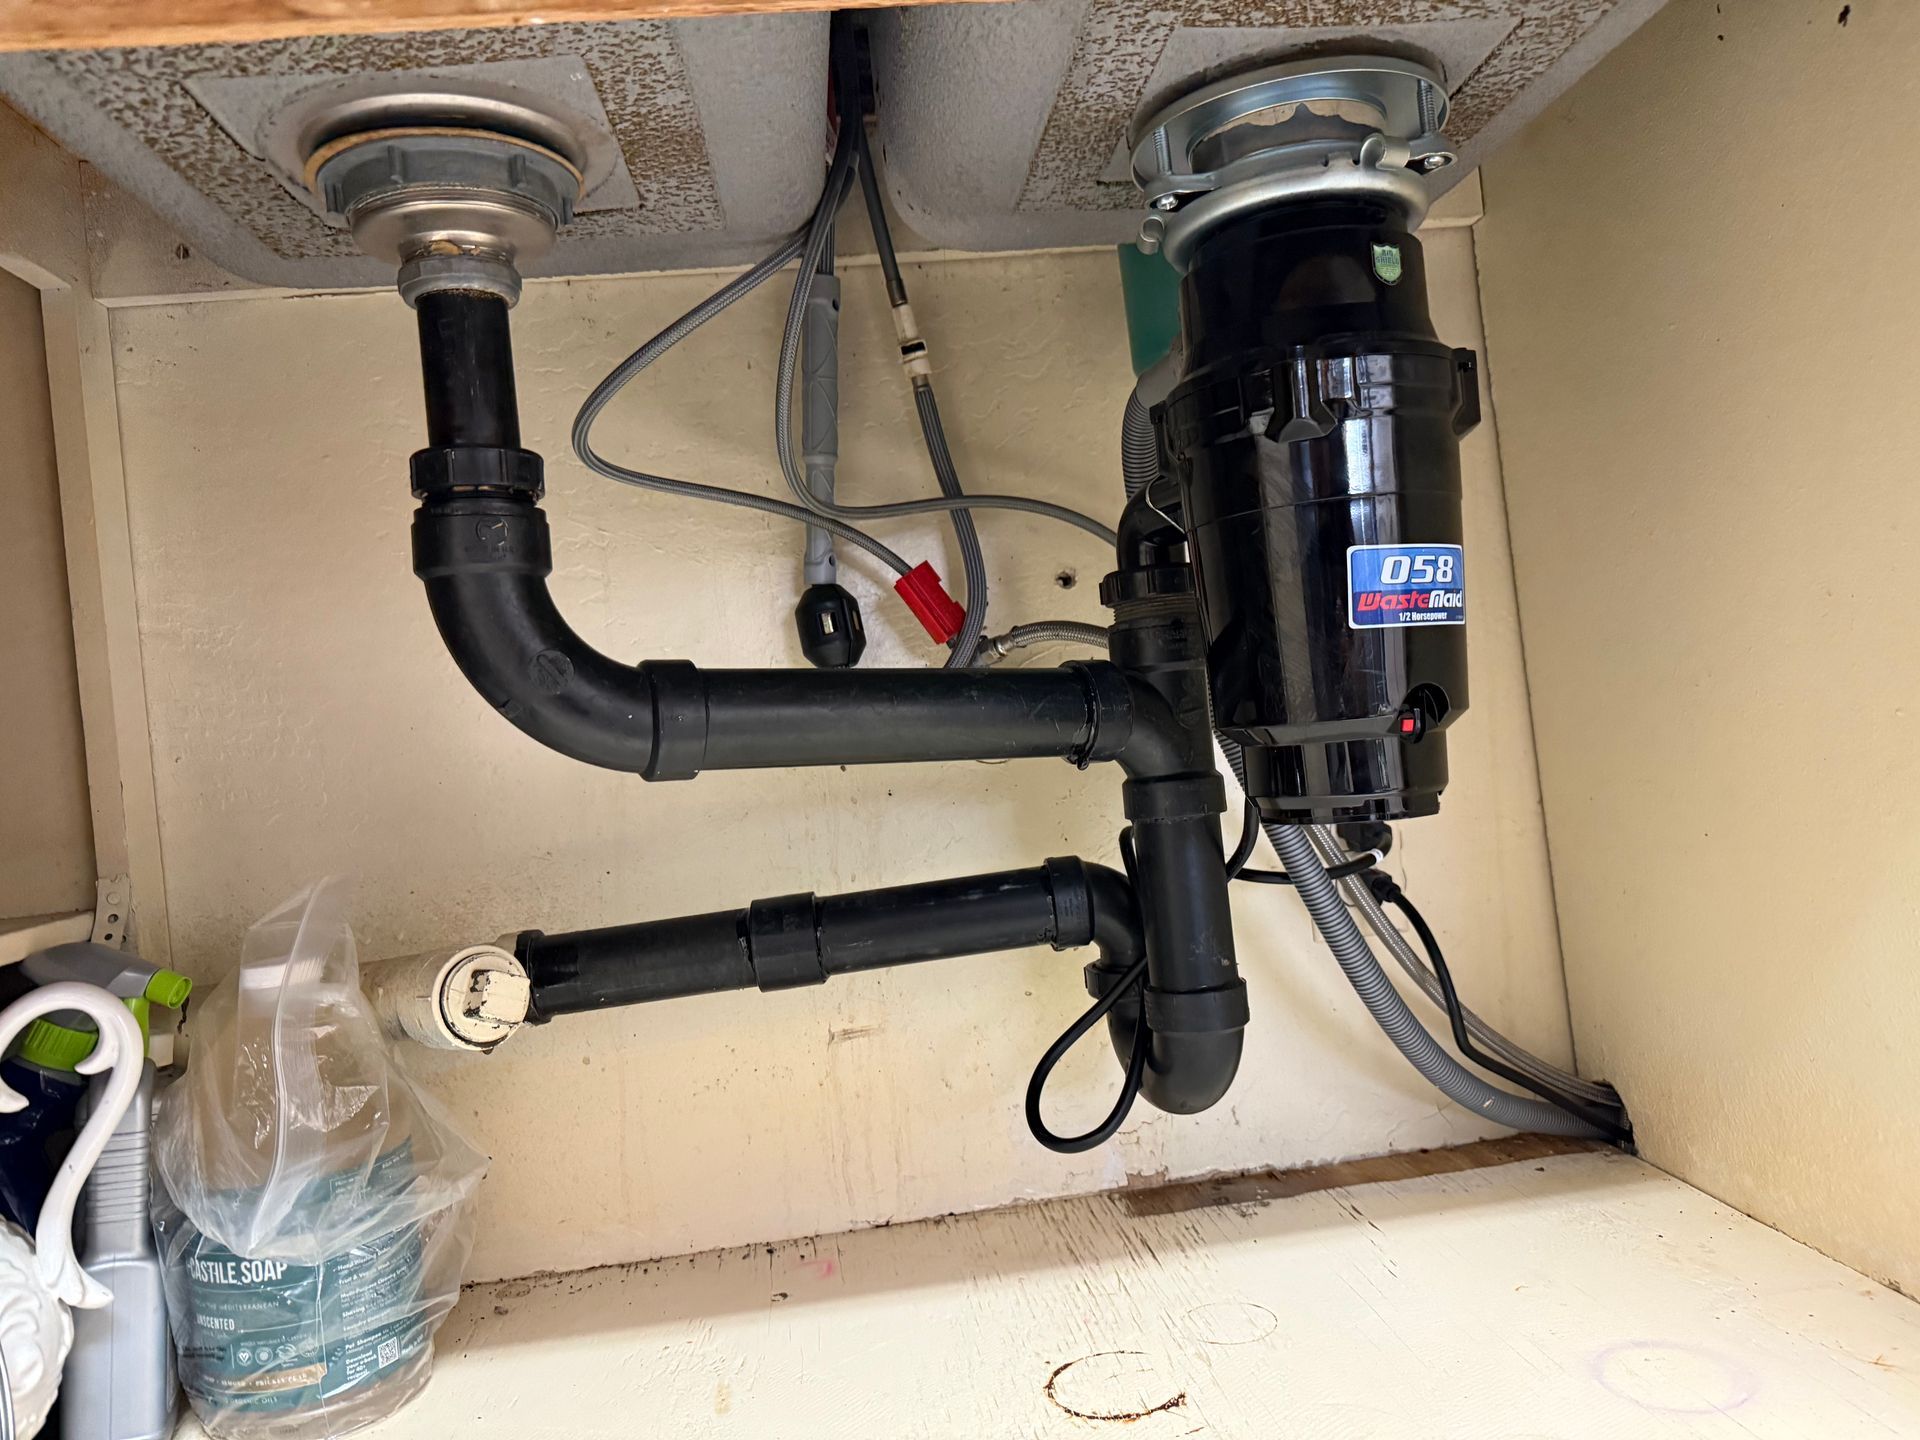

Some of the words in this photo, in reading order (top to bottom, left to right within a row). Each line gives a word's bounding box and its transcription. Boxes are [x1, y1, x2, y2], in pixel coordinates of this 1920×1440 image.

[1380, 555, 1454, 584] 058
[1398, 612, 1411, 622] 1/2
[1411, 611, 1448, 622] Horsepower
[189, 1258, 237, 1285] CASTILE
[240, 1259, 288, 1284] SOAP
